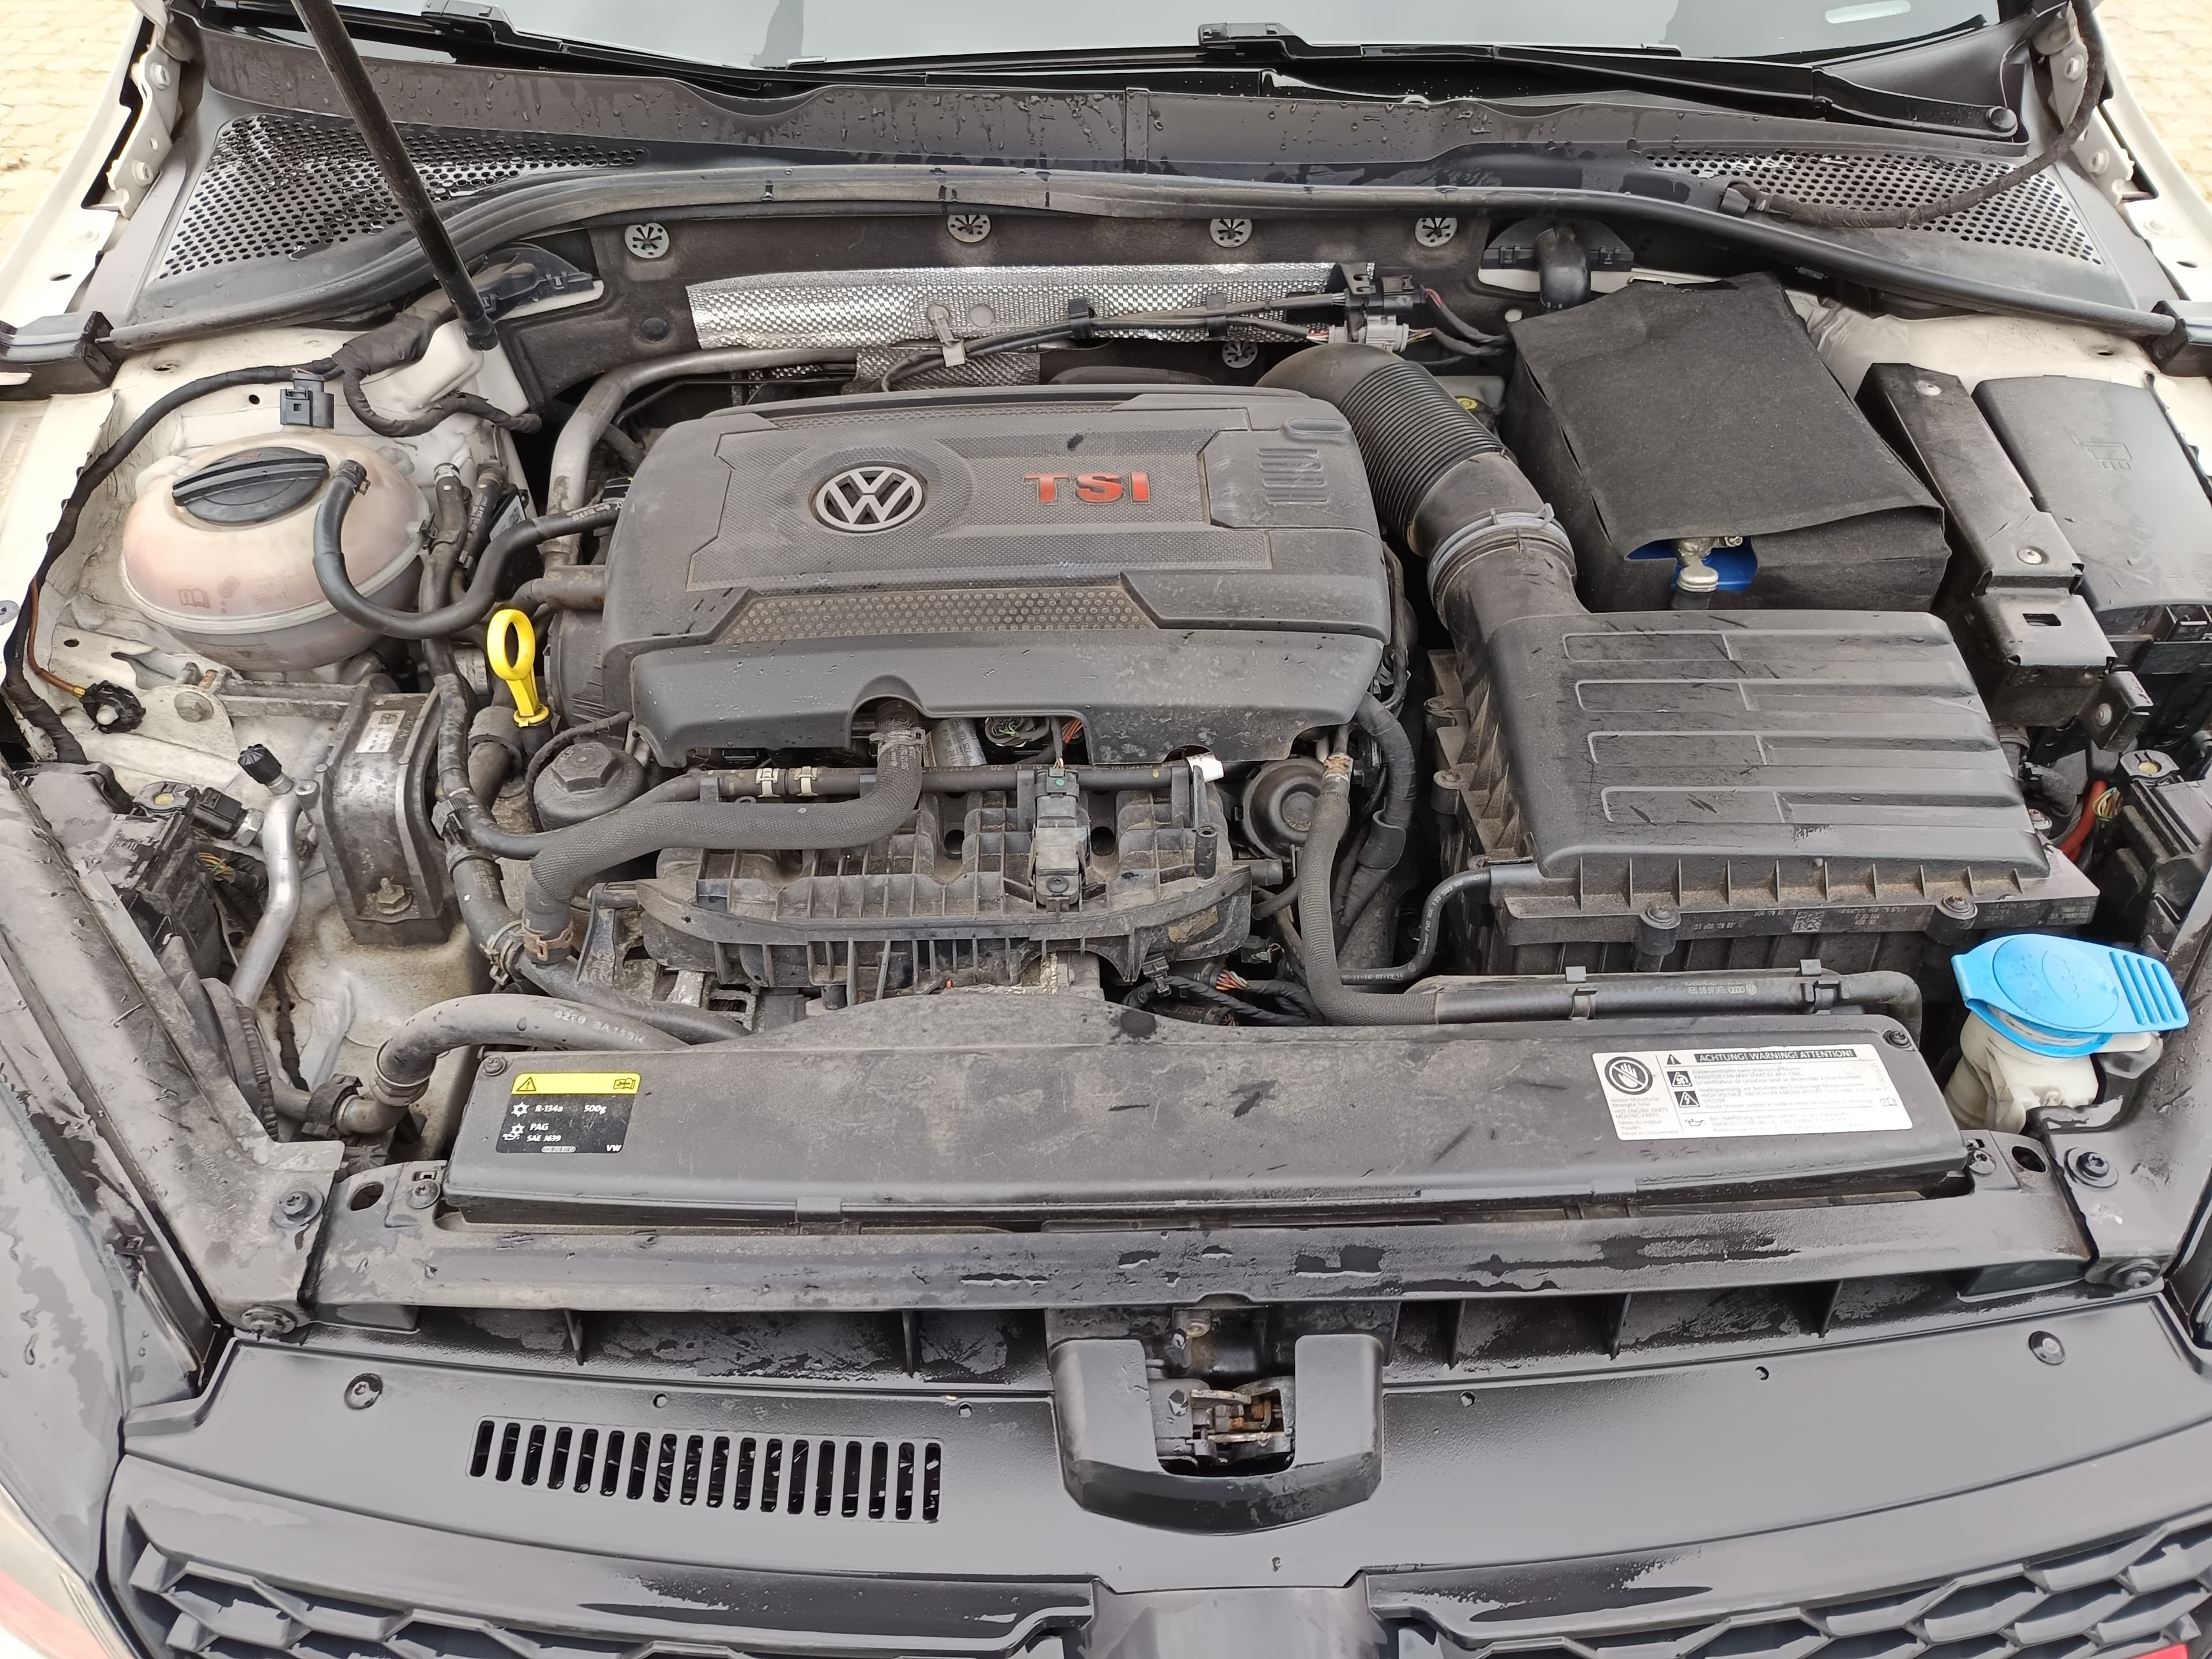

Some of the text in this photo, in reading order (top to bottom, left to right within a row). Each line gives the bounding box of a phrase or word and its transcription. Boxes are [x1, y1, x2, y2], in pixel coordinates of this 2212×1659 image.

[1024, 471, 1150, 505] TSI
[816, 466, 923, 531] VW
[1699, 1050, 1853, 1062] ACHTUNG! WARNING! ATTENTION!
[535, 1104, 607, 1114] R-134a 500g
[605, 1144, 622, 1152] VW
